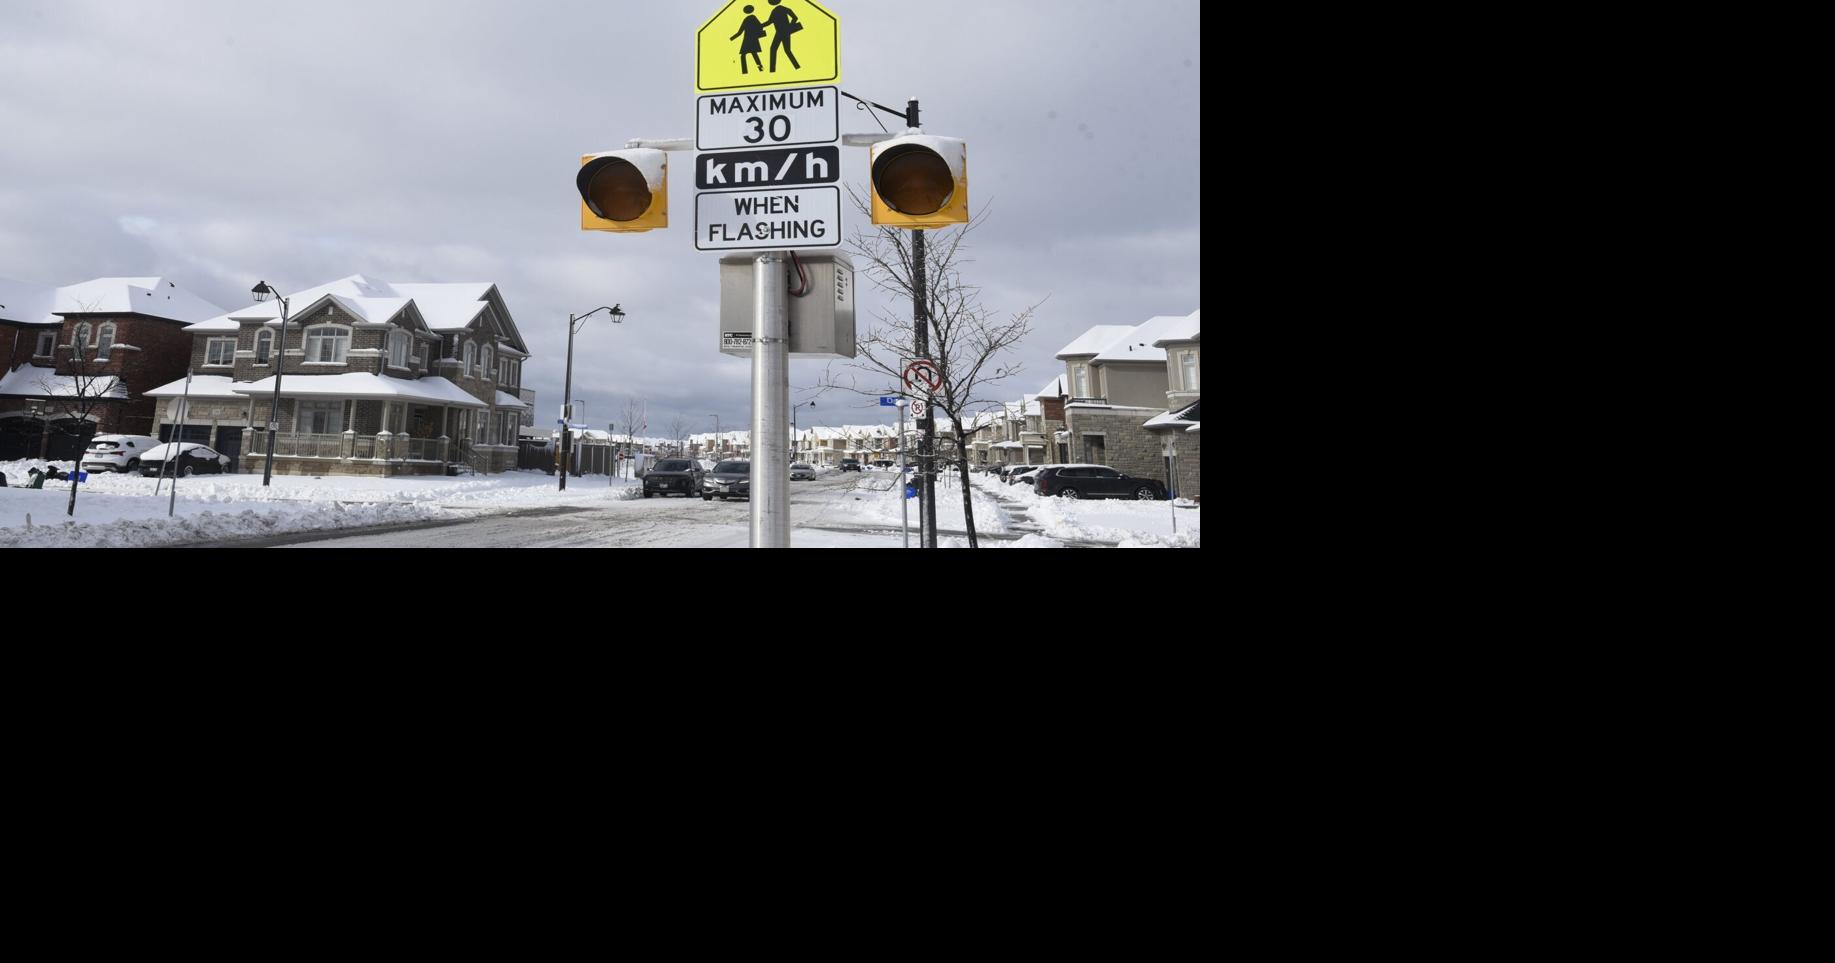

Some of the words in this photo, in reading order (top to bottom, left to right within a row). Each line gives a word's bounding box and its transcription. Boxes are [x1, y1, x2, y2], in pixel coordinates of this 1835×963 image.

[710, 90, 824, 115] MAXIMUM
[743, 114, 791, 143] 30
[706, 152, 828, 184] km/h
[734, 195, 799, 215] WHEN
[709, 220, 825, 242] FLASHING
